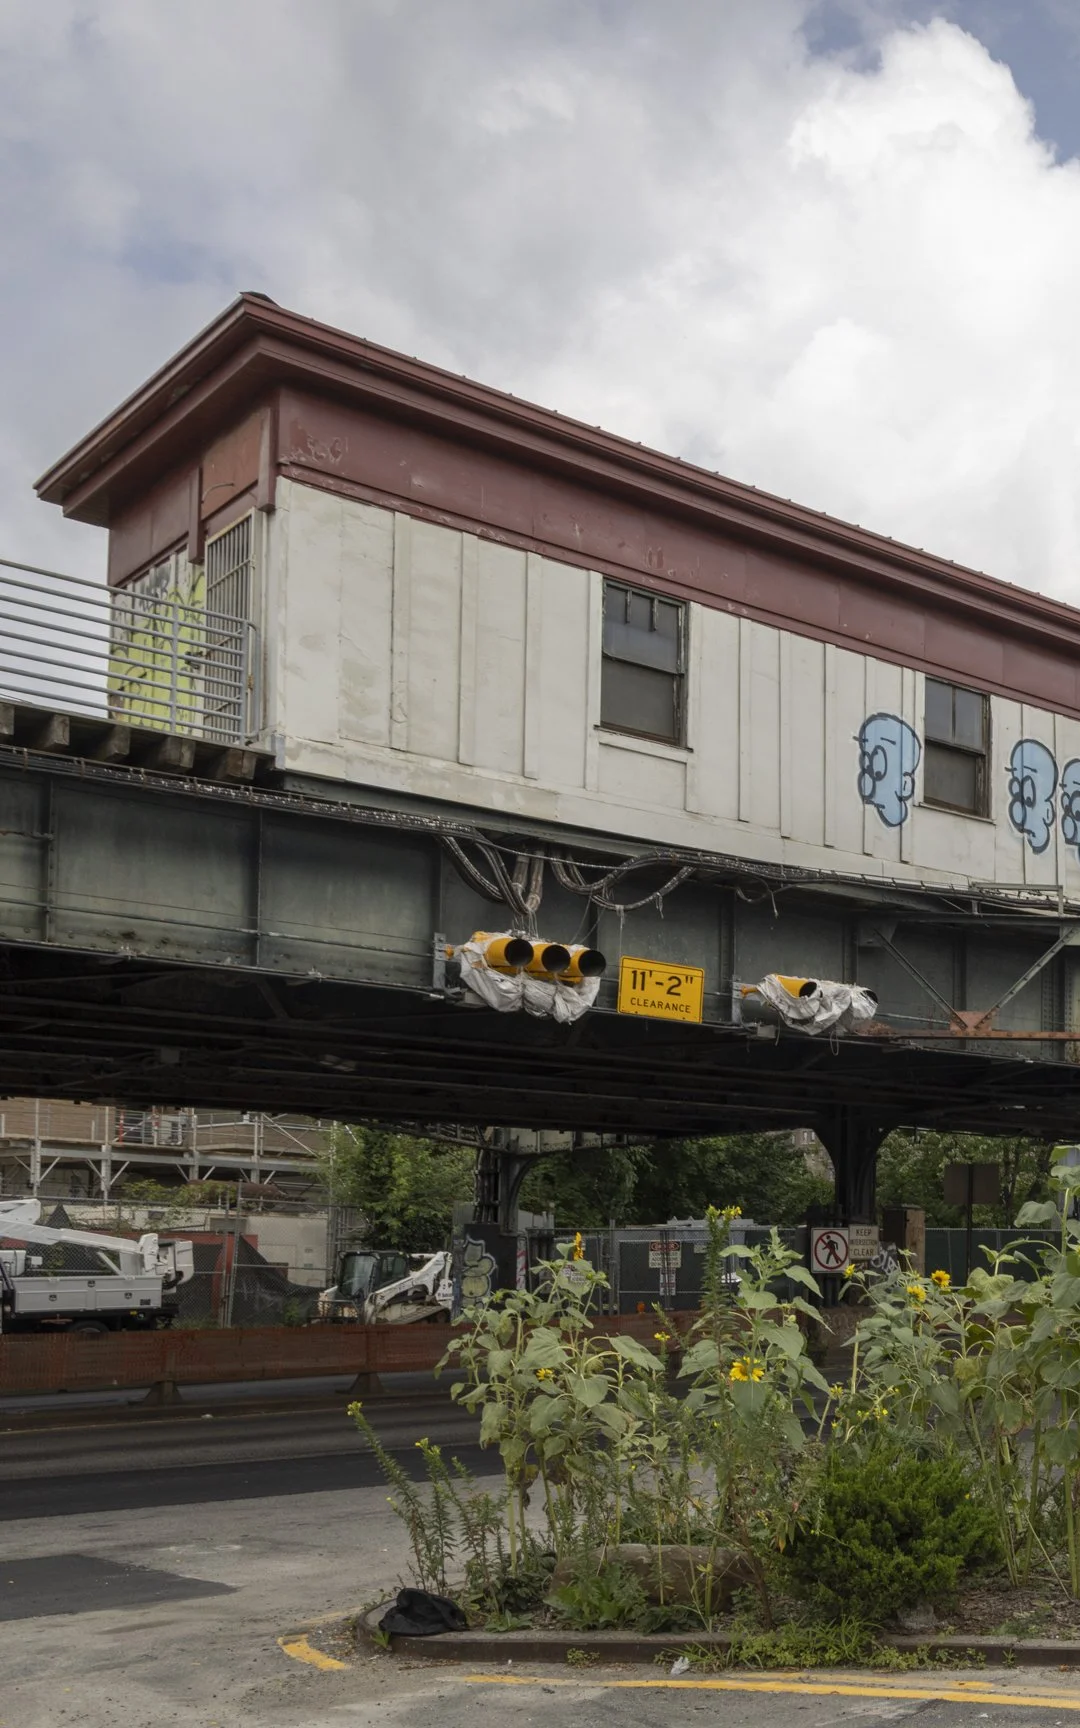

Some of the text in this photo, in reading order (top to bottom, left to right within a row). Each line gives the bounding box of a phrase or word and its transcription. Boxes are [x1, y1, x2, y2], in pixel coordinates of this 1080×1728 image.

[630, 997, 692, 1014] CLEARANCE
[855, 1228, 872, 1237] KEEP
[853, 1248, 874, 1257] CLEAR
